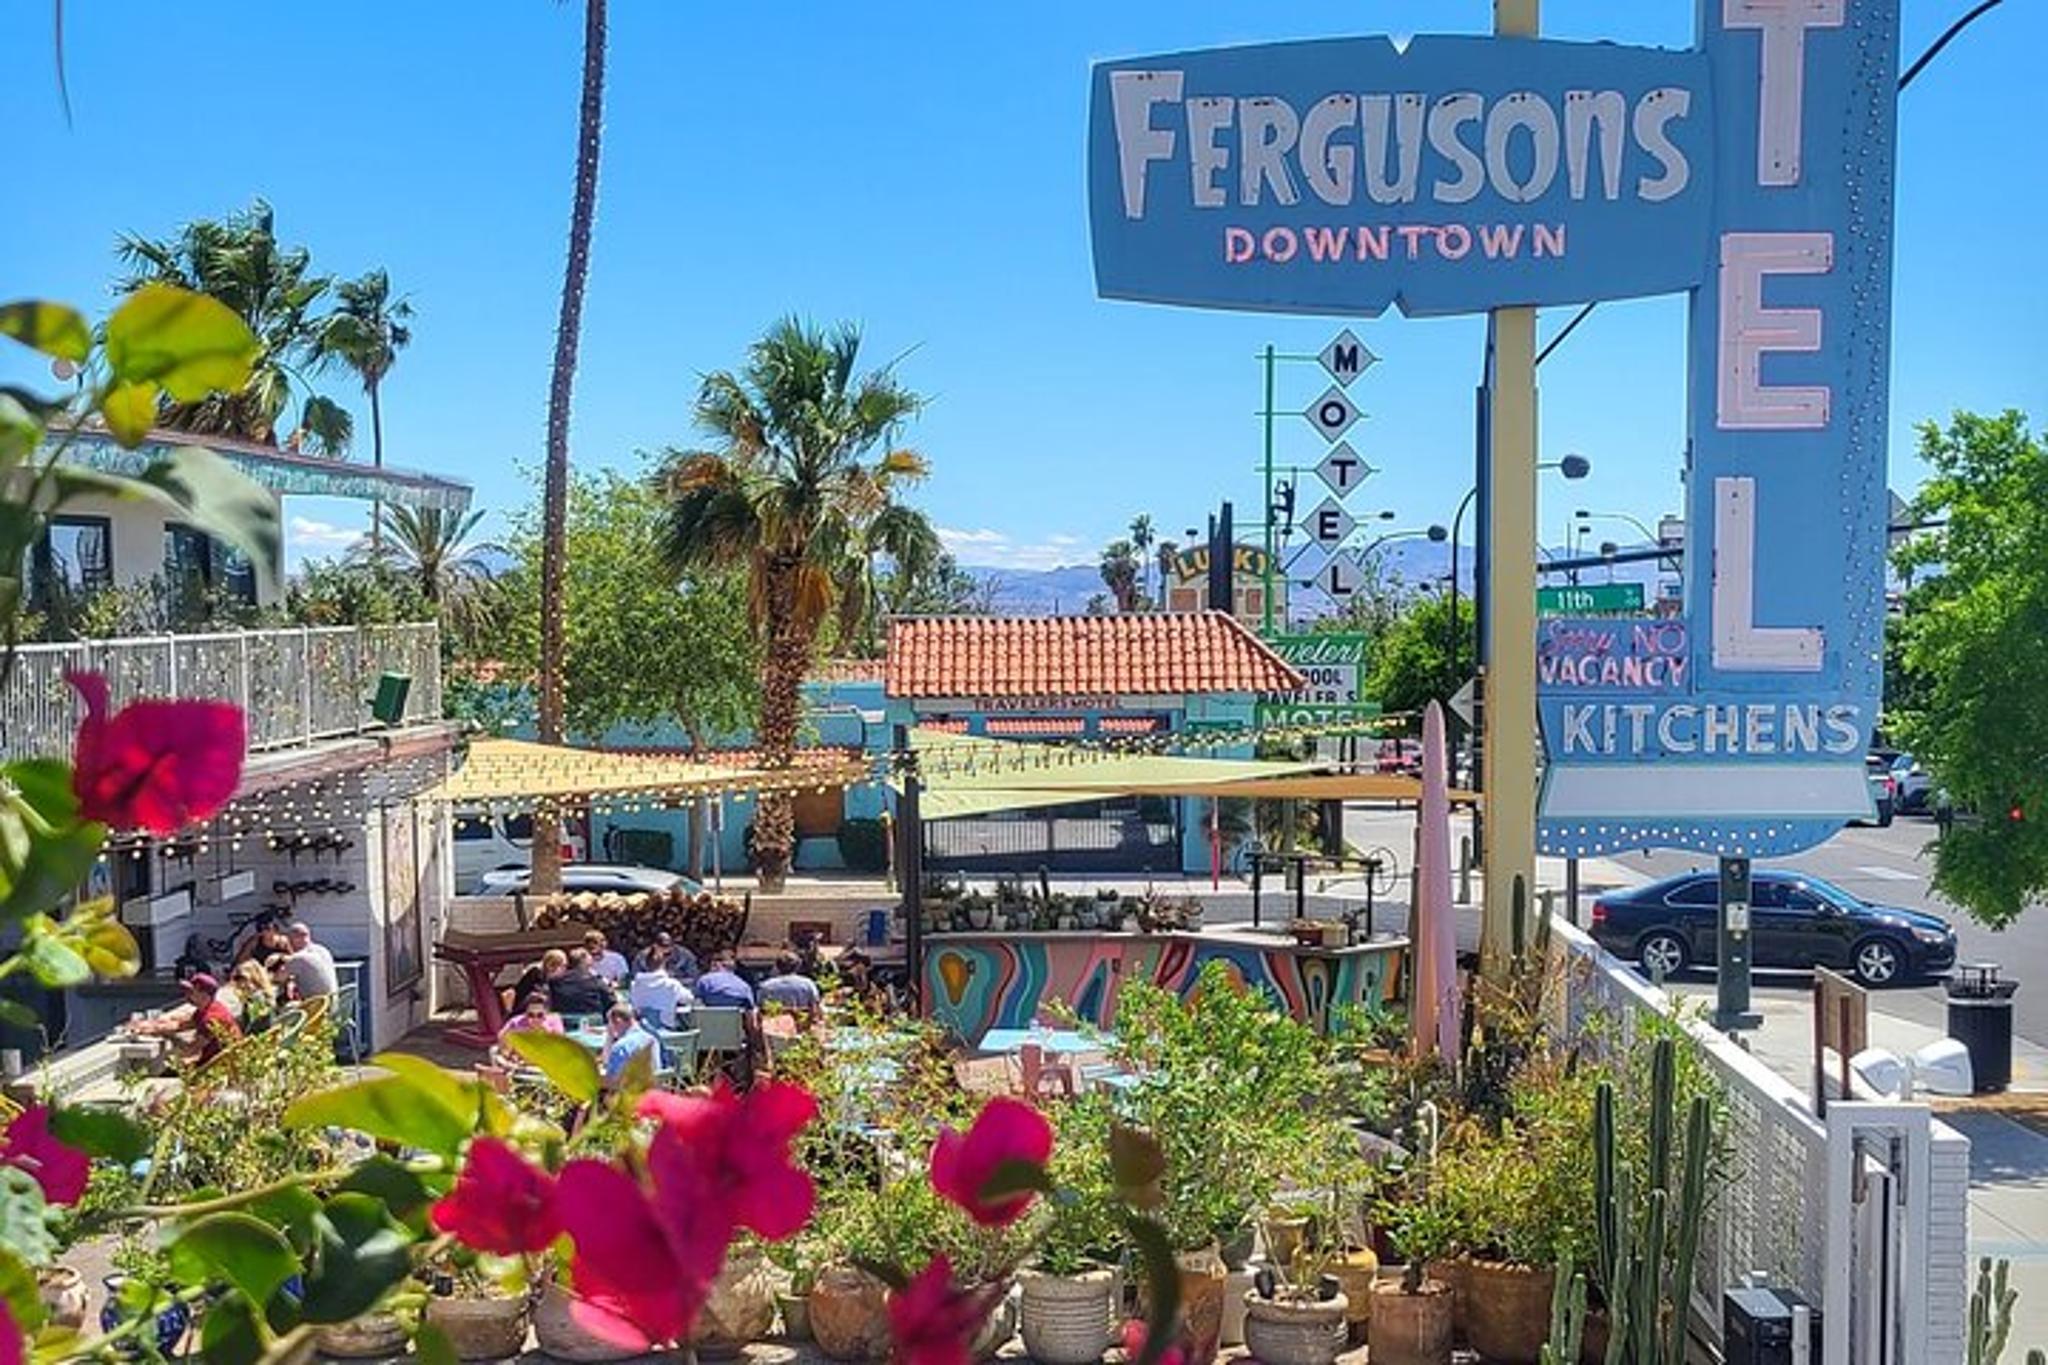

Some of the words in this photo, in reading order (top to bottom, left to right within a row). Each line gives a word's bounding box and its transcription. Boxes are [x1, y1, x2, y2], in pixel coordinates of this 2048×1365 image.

[1109, 69, 1691, 220] FERGUSONS
[1224, 225, 1567, 264] DOWNTOWN
[1319, 344, 1358, 595] MOTEL
[1558, 590, 1594, 609] 11th
[1542, 619, 1617, 656] Sorry
[1634, 624, 1686, 654] NO
[1538, 654, 1689, 687] VACANCY
[1562, 702, 1862, 755] KITCHENS
